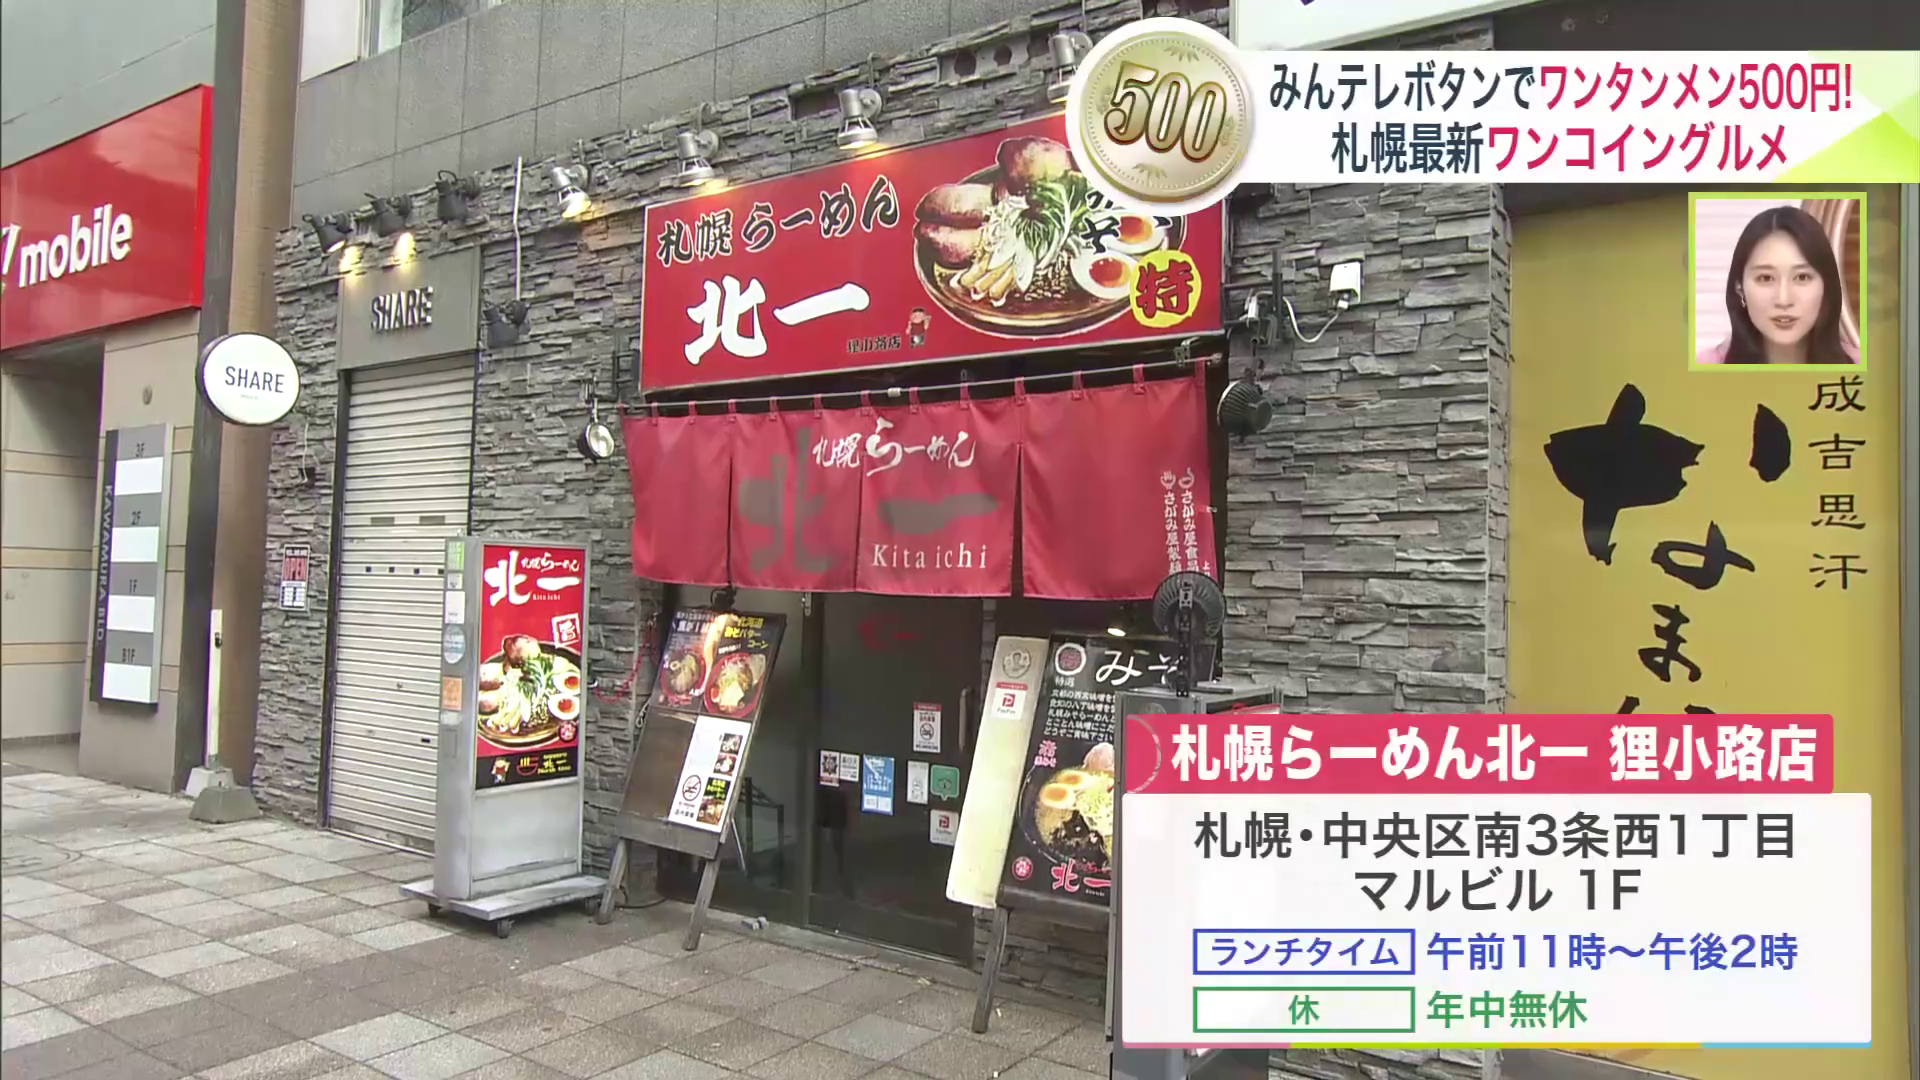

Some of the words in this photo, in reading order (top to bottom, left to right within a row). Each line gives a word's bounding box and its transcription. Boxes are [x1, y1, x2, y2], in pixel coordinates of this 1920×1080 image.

[371, 286, 433, 333] SHARE
[1136, 258, 1193, 319] 特
[684, 275, 870, 365] 北一
[225, 366, 285, 393] SHARE
[812, 416, 976, 477] 札幌らーめん
[1808, 375, 1867, 590] 成吉思汗
[100, 485, 113, 601] KAWAMURA
[1543, 383, 1791, 714] なま
[484, 550, 580, 607] 北一
